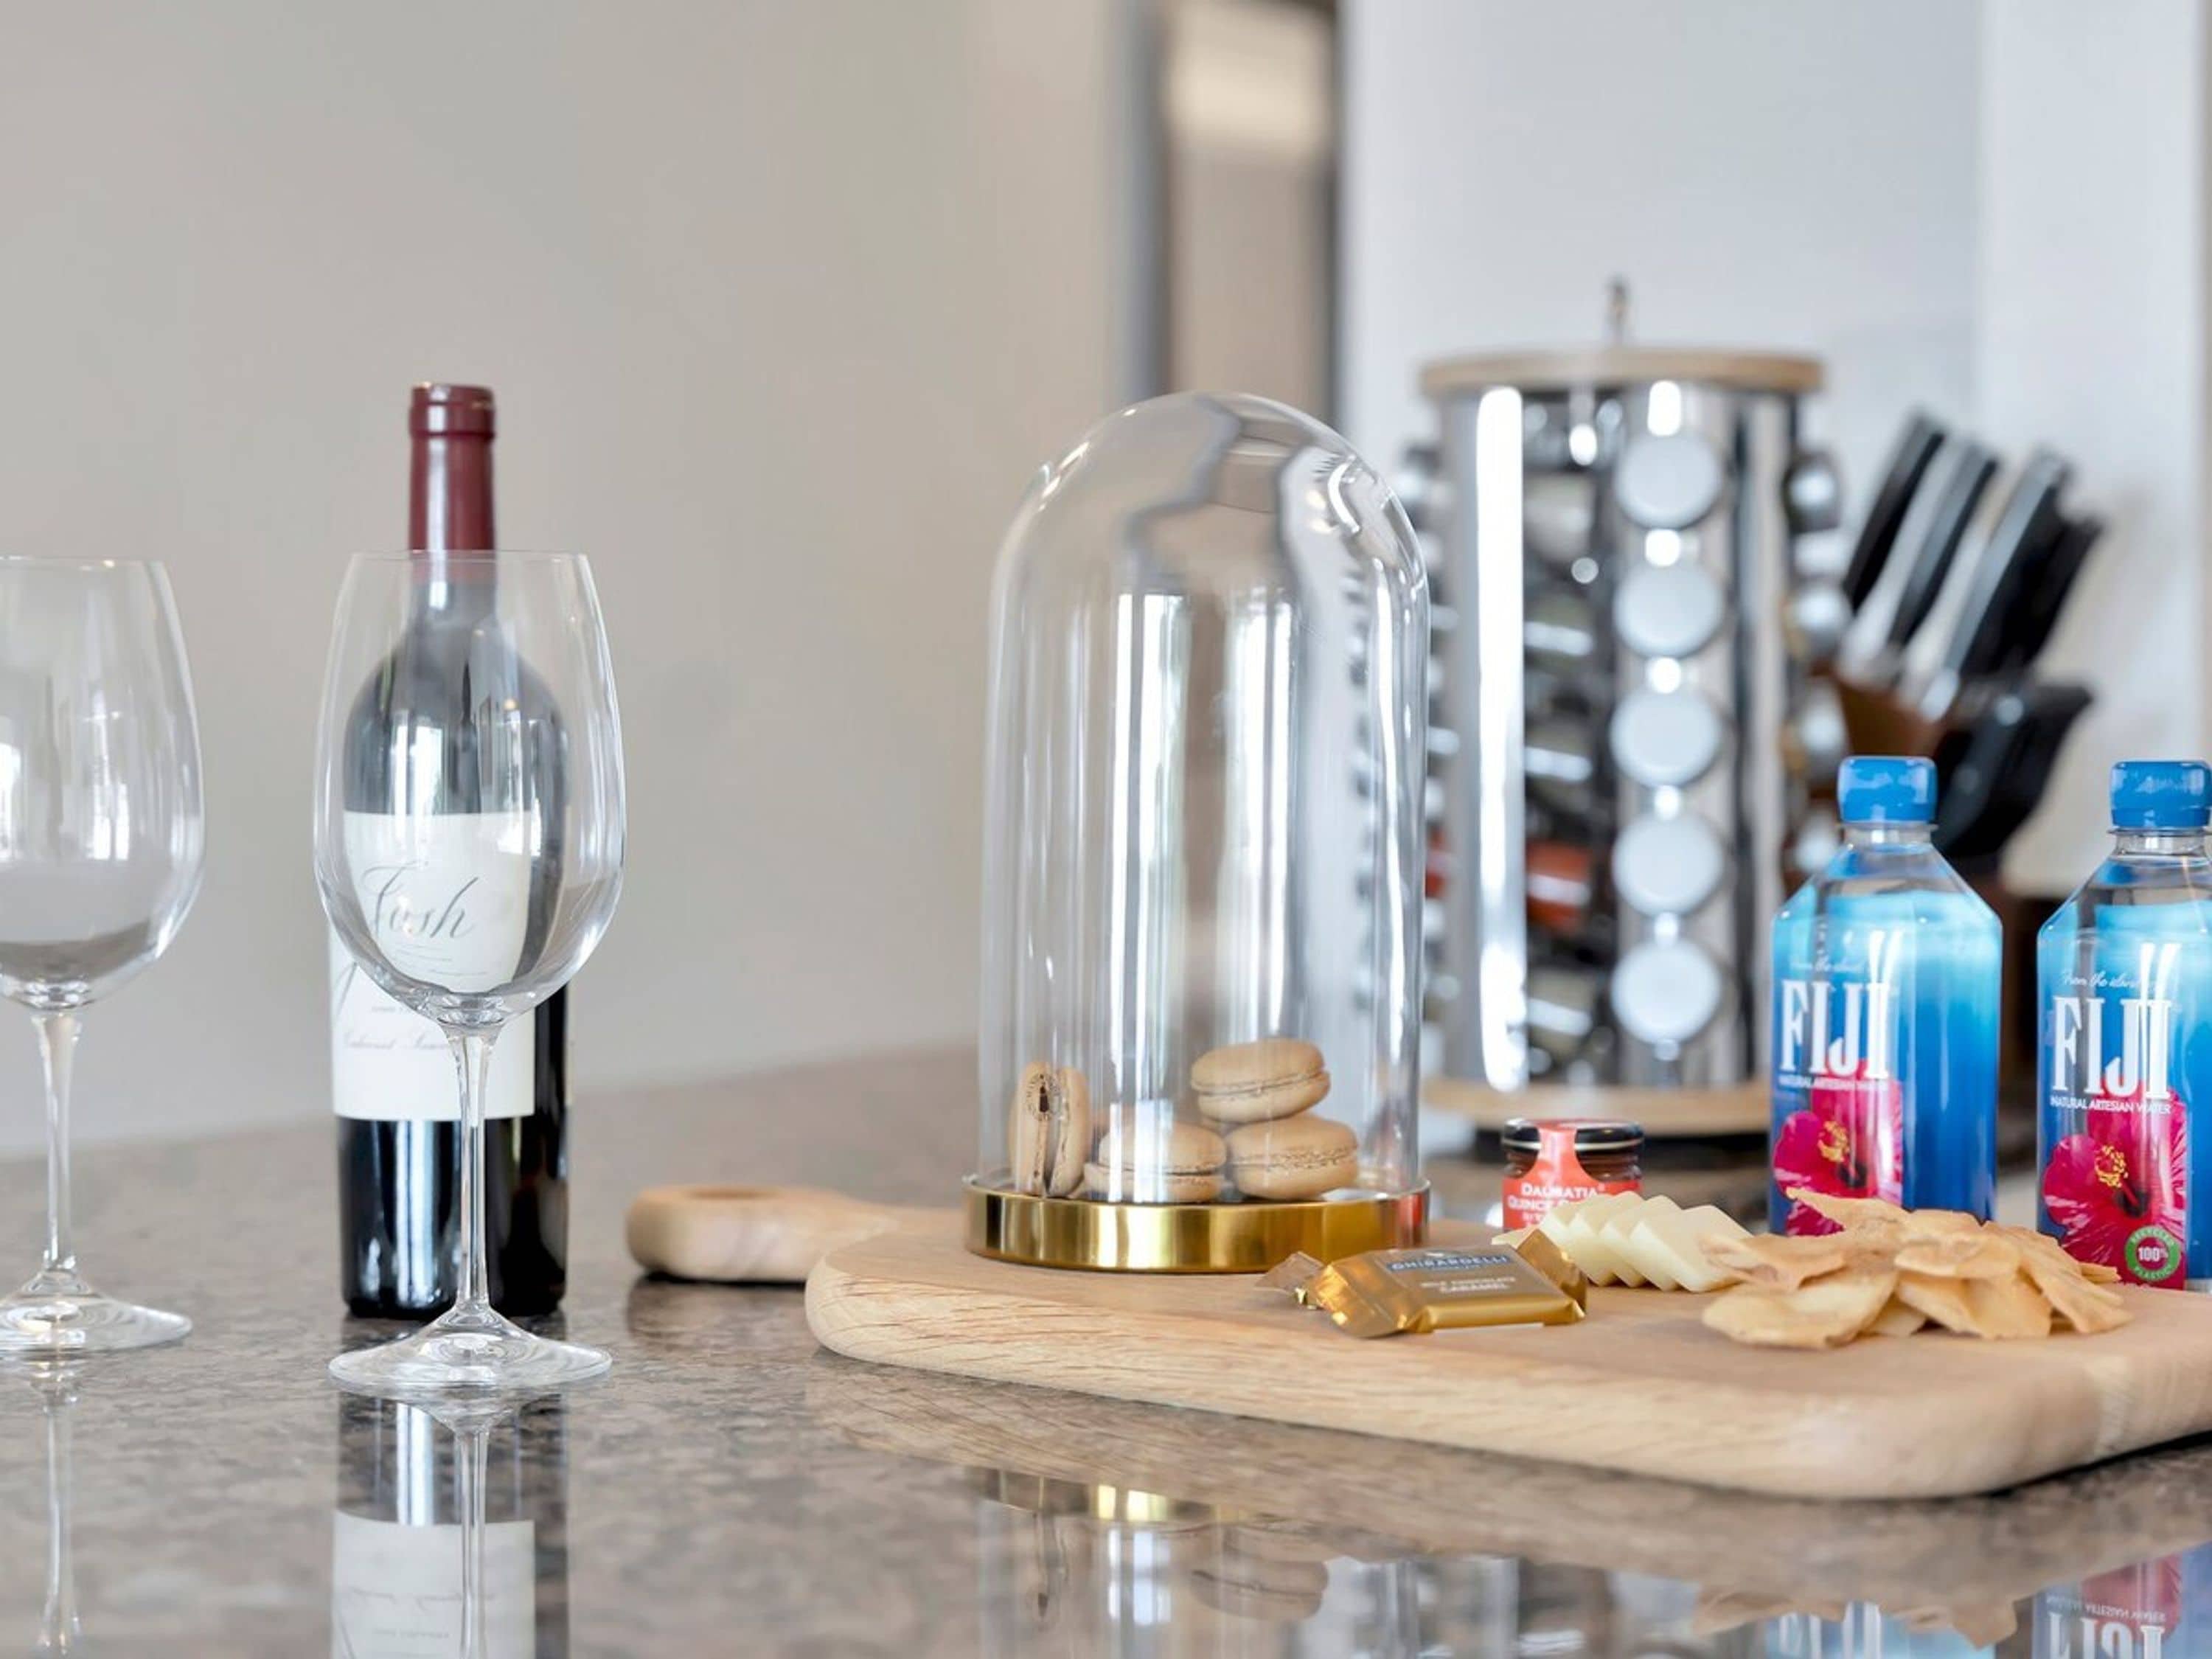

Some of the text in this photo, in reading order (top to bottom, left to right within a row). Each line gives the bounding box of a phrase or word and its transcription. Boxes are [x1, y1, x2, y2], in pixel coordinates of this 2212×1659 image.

[1779, 980, 1889, 1079] FIJI
[2051, 996, 2171, 1098] FIJI
[2050, 1095, 2171, 1114] NATURAL ARTESIAN WATER
[1391, 1256, 1508, 1270] GHIRARDELLI
